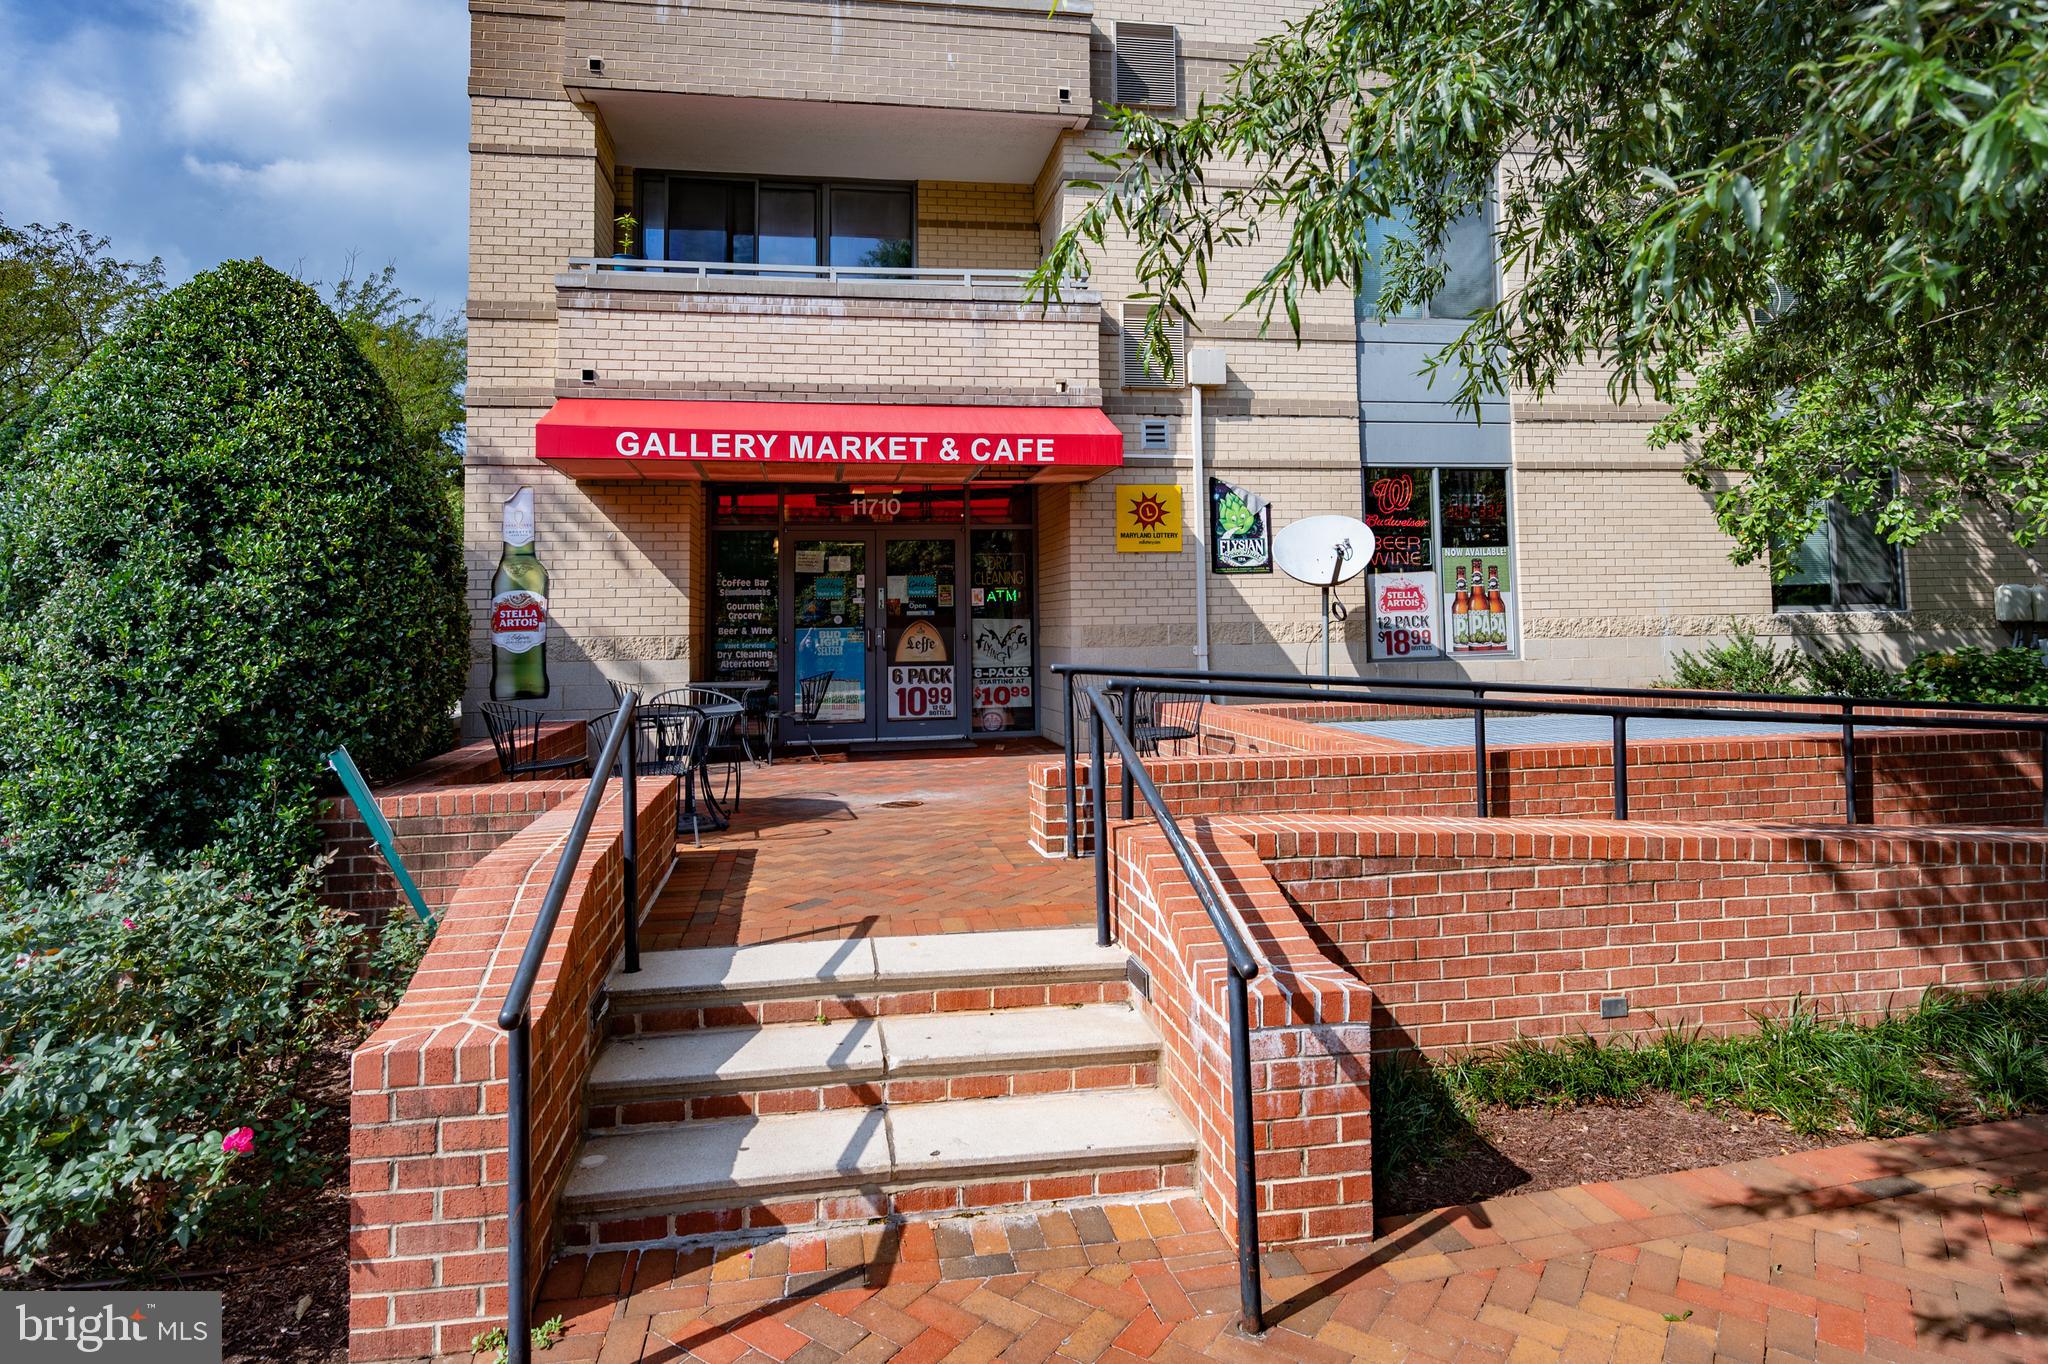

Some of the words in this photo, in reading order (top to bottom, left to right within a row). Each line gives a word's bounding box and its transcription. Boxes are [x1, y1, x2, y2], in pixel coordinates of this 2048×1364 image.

[615, 431, 778, 458] GALLERY
[789, 435, 928, 460] MARKET
[939, 437, 961, 461] &
[970, 438, 1055, 462] CAFE
[850, 498, 901, 516] 11710
[1146, 507, 1153, 516] L
[1365, 514, 1429, 527] Budweiser
[1375, 535, 1420, 550] BEER
[1219, 540, 1264, 557] ELYSIAN
[1445, 548, 1463, 557] NOW
[1465, 547, 1507, 557] AVAILABLE!
[988, 555, 1008, 570] DRY
[1371, 551, 1421, 565] WINE
[721, 579, 751, 587] Coffee
[754, 579, 769, 587] Bar
[974, 570, 1024, 586] CLEANING
[986, 589, 1017, 602] ATM
[1387, 591, 1419, 599] STELLA
[726, 603, 765, 611] Gourmet
[908, 602, 927, 610] Open
[1387, 599, 1420, 607] ARTOIS
[500, 609, 538, 619] STELLA
[728, 612, 762, 620] Grocery
[499, 617, 539, 627] ARTOIS
[1377, 616, 1393, 629] 12
[1395, 615, 1430, 629] PACK
[718, 627, 738, 635] Beer
[741, 641, 767, 649] Services
[815, 638, 845, 647] LIGHT
[906, 636, 937, 653] Leffe
[717, 651, 735, 659] Dry
[735, 650, 773, 659] Cleaning
[817, 647, 843, 656] SELTZER
[720, 660, 770, 668] Alterations
[892, 669, 904, 685] 6
[907, 668, 953, 685] PACK
[974, 667, 1030, 678] 6-PACKS
